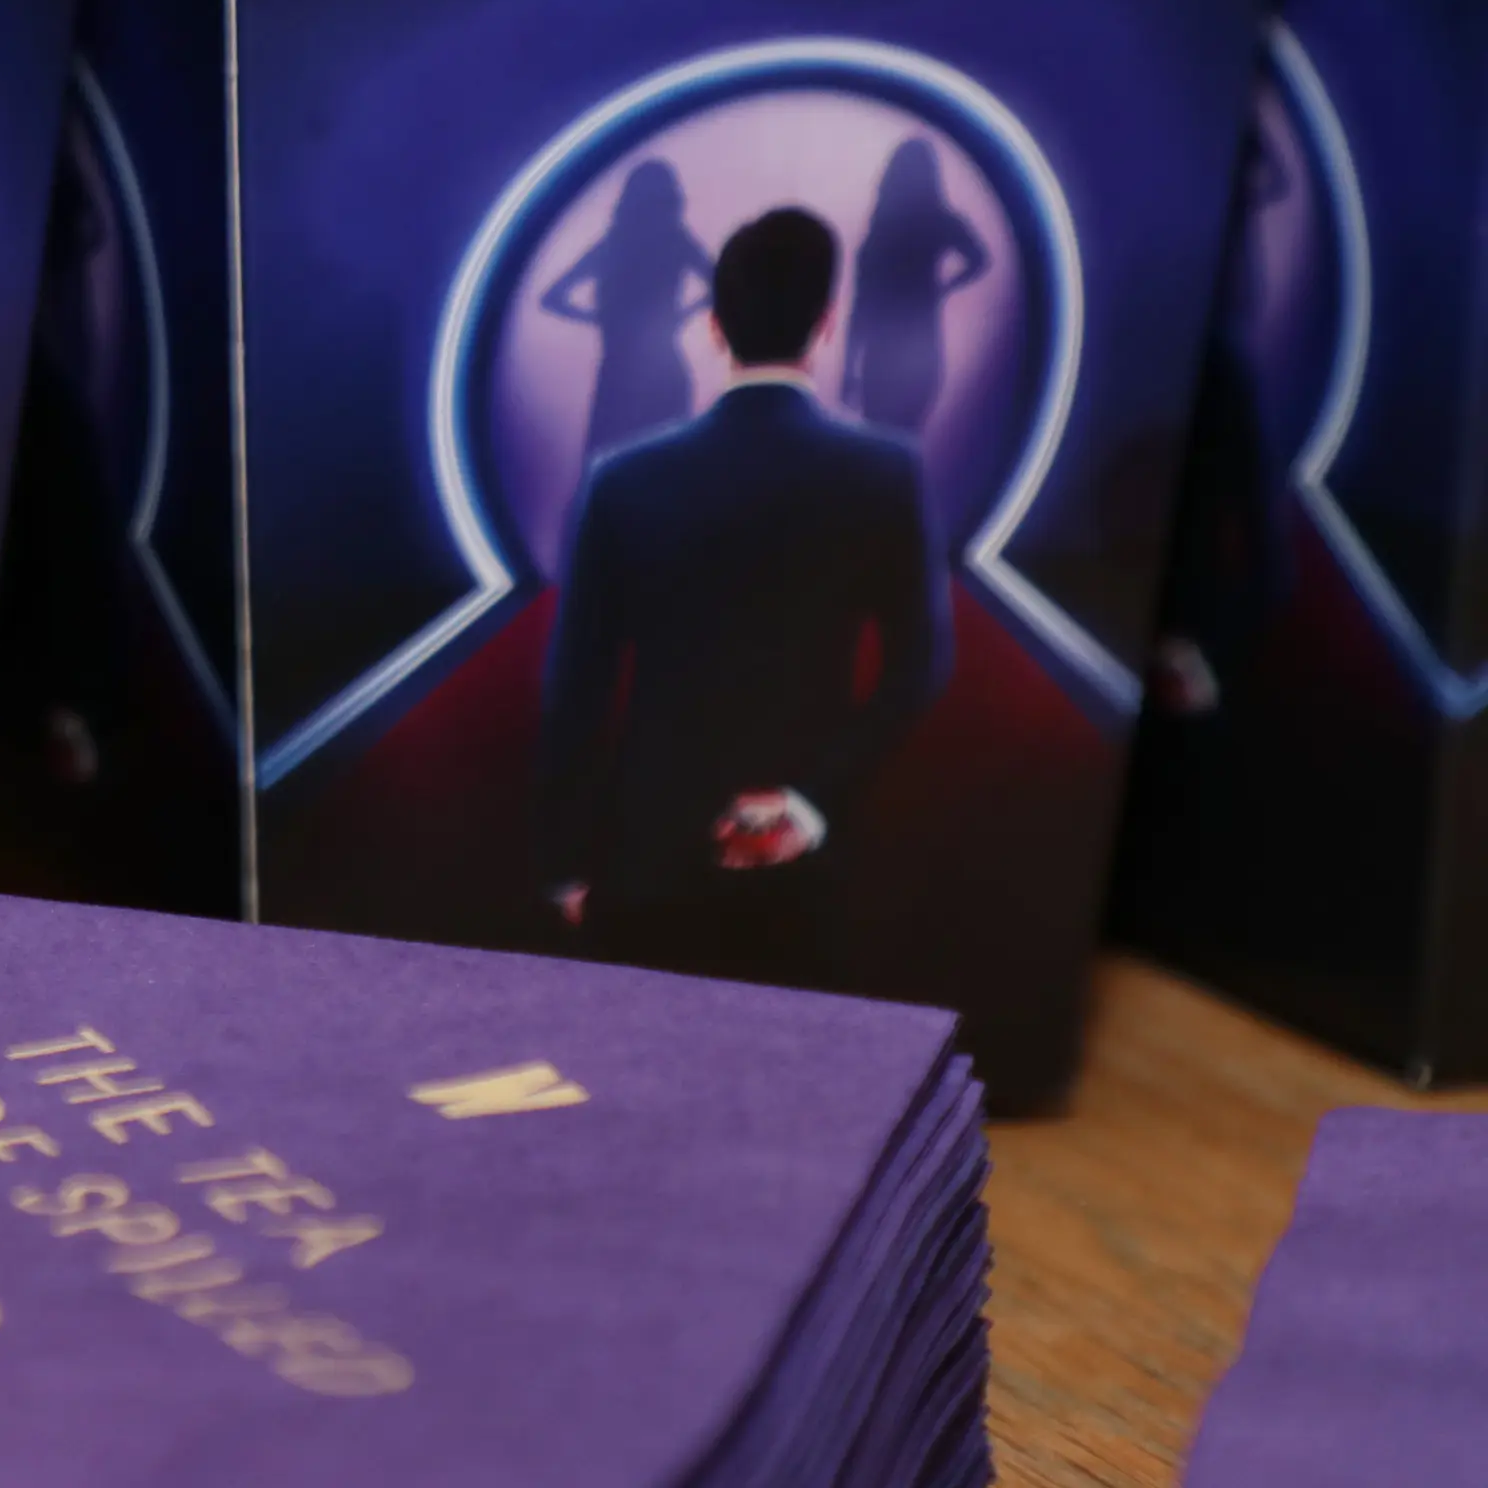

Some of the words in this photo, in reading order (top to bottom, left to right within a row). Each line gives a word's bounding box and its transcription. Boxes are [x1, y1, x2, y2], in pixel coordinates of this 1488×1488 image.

[4, 1024, 215, 1144] THE
[174, 1145, 384, 1270] TEA
[9, 1173, 416, 1398] SPILLED
